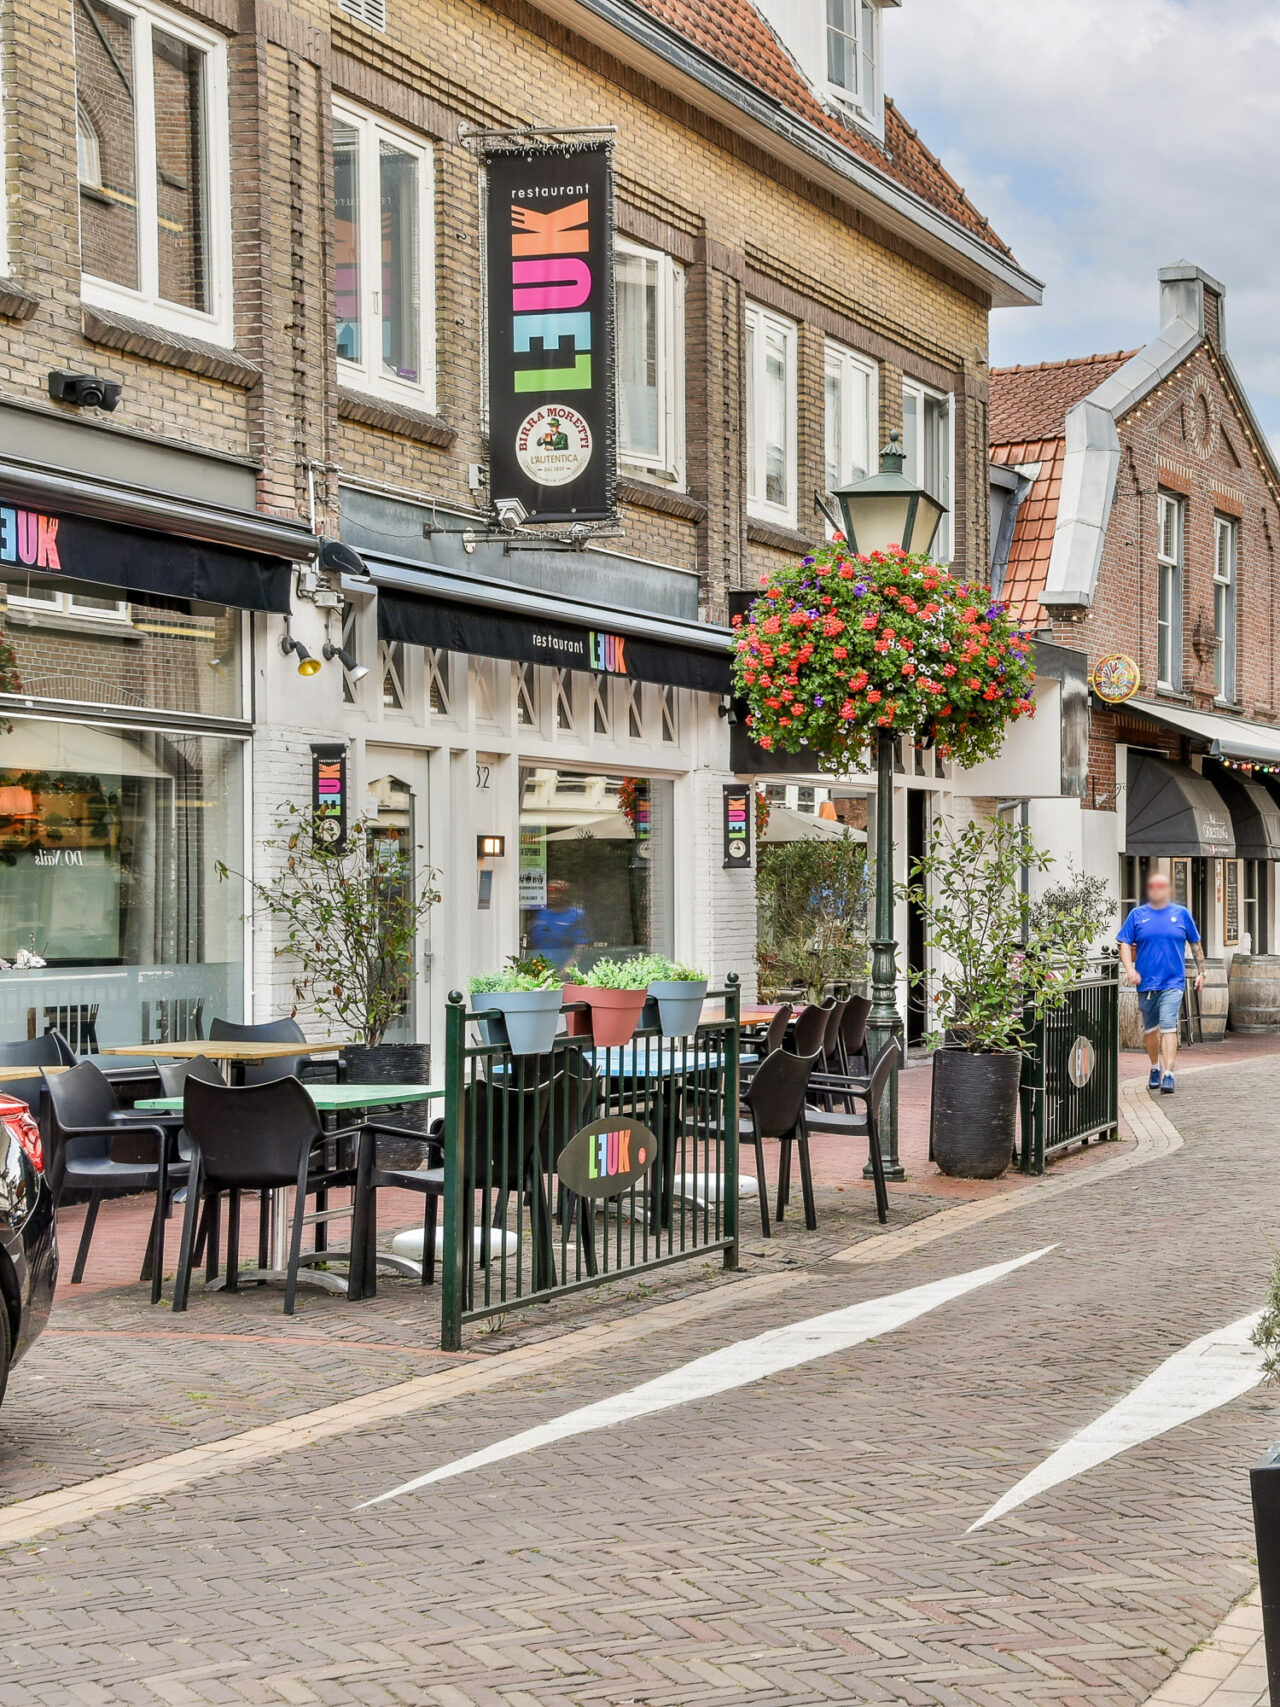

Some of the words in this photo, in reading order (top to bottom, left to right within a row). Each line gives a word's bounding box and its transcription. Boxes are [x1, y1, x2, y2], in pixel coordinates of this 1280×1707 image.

[511, 183, 589, 199] restaurant
[511, 198, 592, 393] LEUK
[519, 412, 545, 452] BIRRA
[547, 407, 590, 449] MORETTI
[530, 454, 579, 465] L'AUTENTICA
[0, 507, 61, 570] EUK
[532, 634, 584, 654] restaurant
[589, 631, 627, 674] LEUK
[318, 763, 341, 816] LEUK
[728, 798, 747, 839] LEUK
[588, 1129, 631, 1180] LEUK
